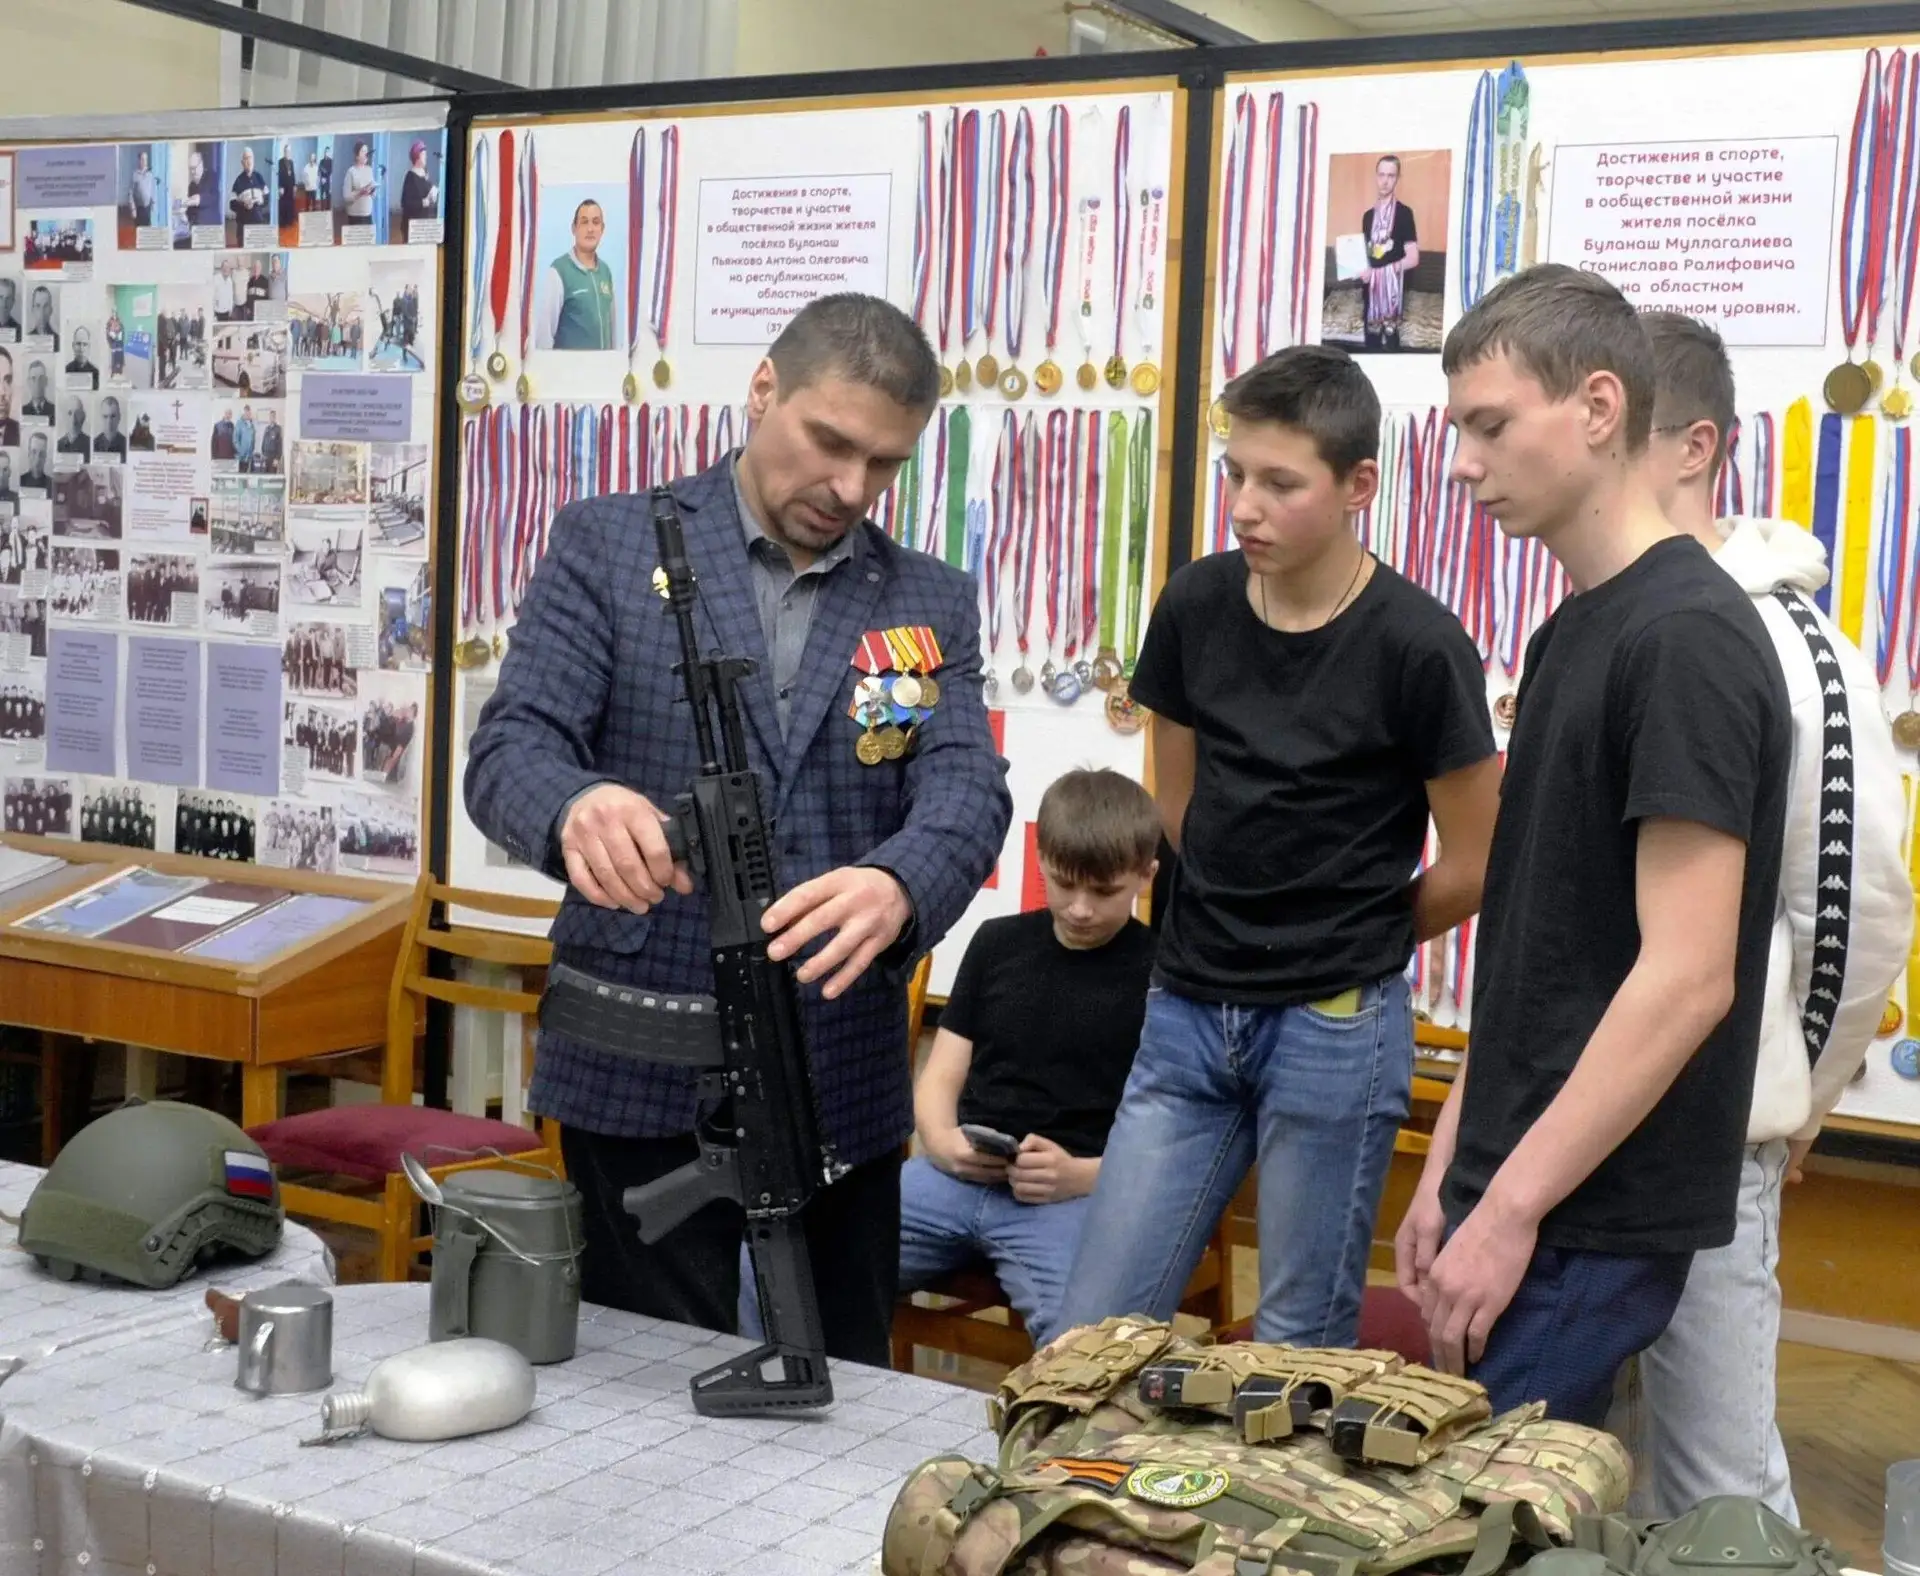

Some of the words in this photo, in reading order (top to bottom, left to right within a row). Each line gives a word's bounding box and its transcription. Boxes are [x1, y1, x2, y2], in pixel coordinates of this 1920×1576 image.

[1597, 151, 1700, 168] Достижения
[1705, 150, 1714, 162] в
[1719, 148, 1784, 165] спорте,
[1596, 173, 1691, 189] творчестве
[1697, 172, 1706, 183] и
[1711, 170, 1783, 187] участие
[732, 189, 798, 201] Достижения
[801, 188, 807, 198] в
[810, 186, 852, 200] спорте,
[1585, 197, 1593, 208] в
[1598, 191, 1733, 210] ообщественной
[1738, 192, 1793, 204] жизни
[732, 206, 793, 217] творчестве
[796, 205, 803, 214] и
[805, 203, 852, 218] участие
[707, 224, 713, 233] в
[716, 219, 795, 234] общественной
[798, 222, 832, 231] жизни
[836, 220, 876, 230] жителя
[1621, 217, 1681, 228] жителя
[1687, 213, 1756, 228] посёлка
[741, 238, 785, 249] посёлка
[788, 238, 839, 251] Буланаш
[1584, 238, 1660, 254] Буланаш
[1665, 237, 1793, 253] Муллагалиева
[711, 256, 763, 266] Пьянкова
[765, 255, 806, 265] Антона
[809, 254, 869, 265] Олеговича
[1579, 259, 1678, 272] Станислава
[1683, 258, 1795, 273] Ралифовича
[729, 273, 743, 282] на
[745, 270, 848, 286] республиканском,
[1620, 282, 1641, 293] на
[1650, 278, 1743, 293] областном
[757, 288, 817, 299] областном
[711, 307, 718, 316] и
[1634, 302, 1717, 314] ипальном
[1723, 302, 1801, 318] уровнях.
